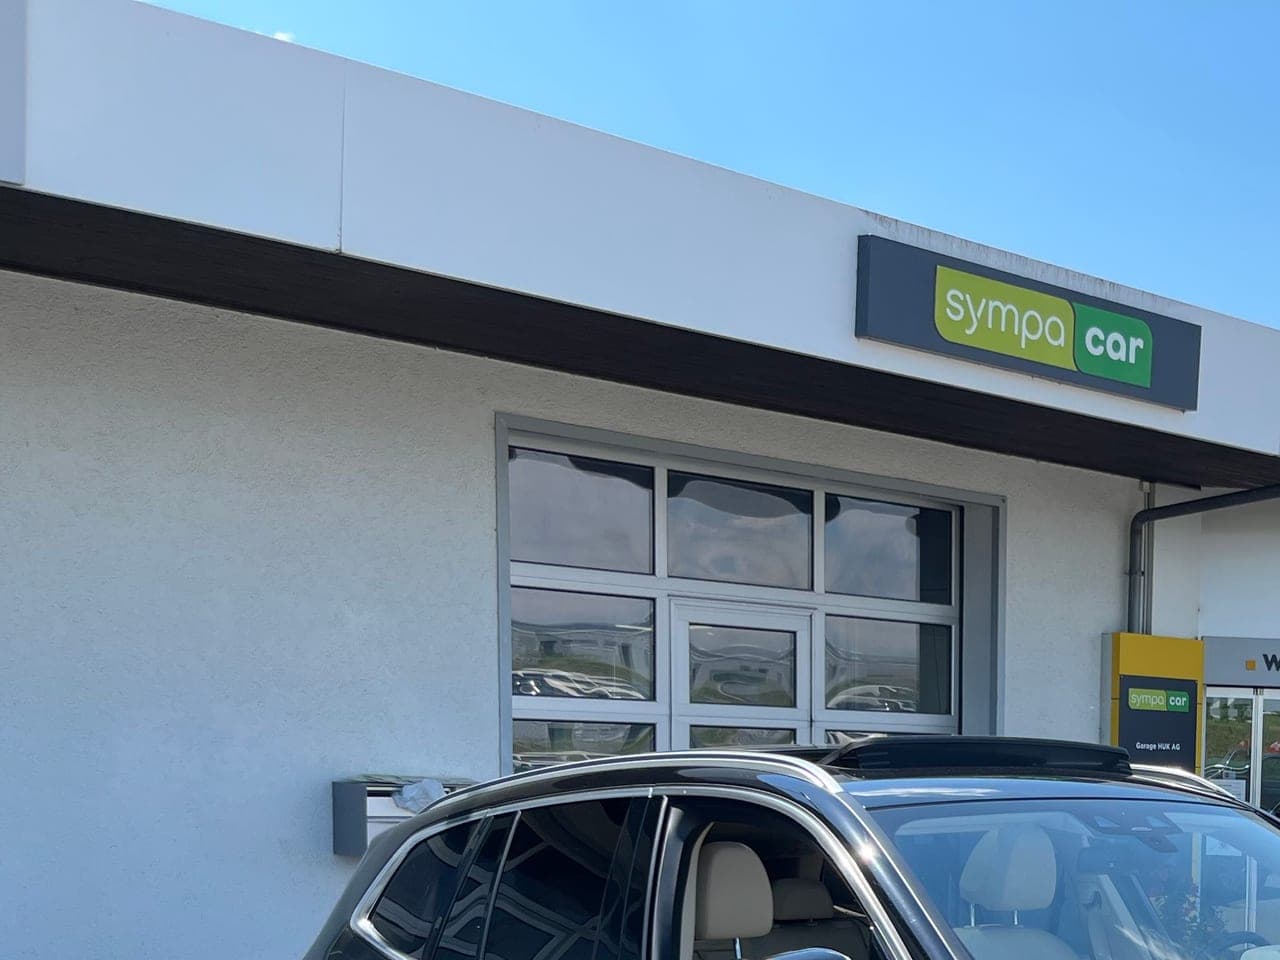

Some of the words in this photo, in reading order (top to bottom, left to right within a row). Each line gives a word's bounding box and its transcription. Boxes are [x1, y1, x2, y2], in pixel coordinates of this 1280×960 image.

[946, 288, 1065, 349] sympa
[1084, 326, 1144, 364] car
[1131, 694, 1164, 707] sympa
[1169, 696, 1187, 707] car
[1136, 742, 1157, 751] Garage
[1171, 743, 1181, 751] AG
